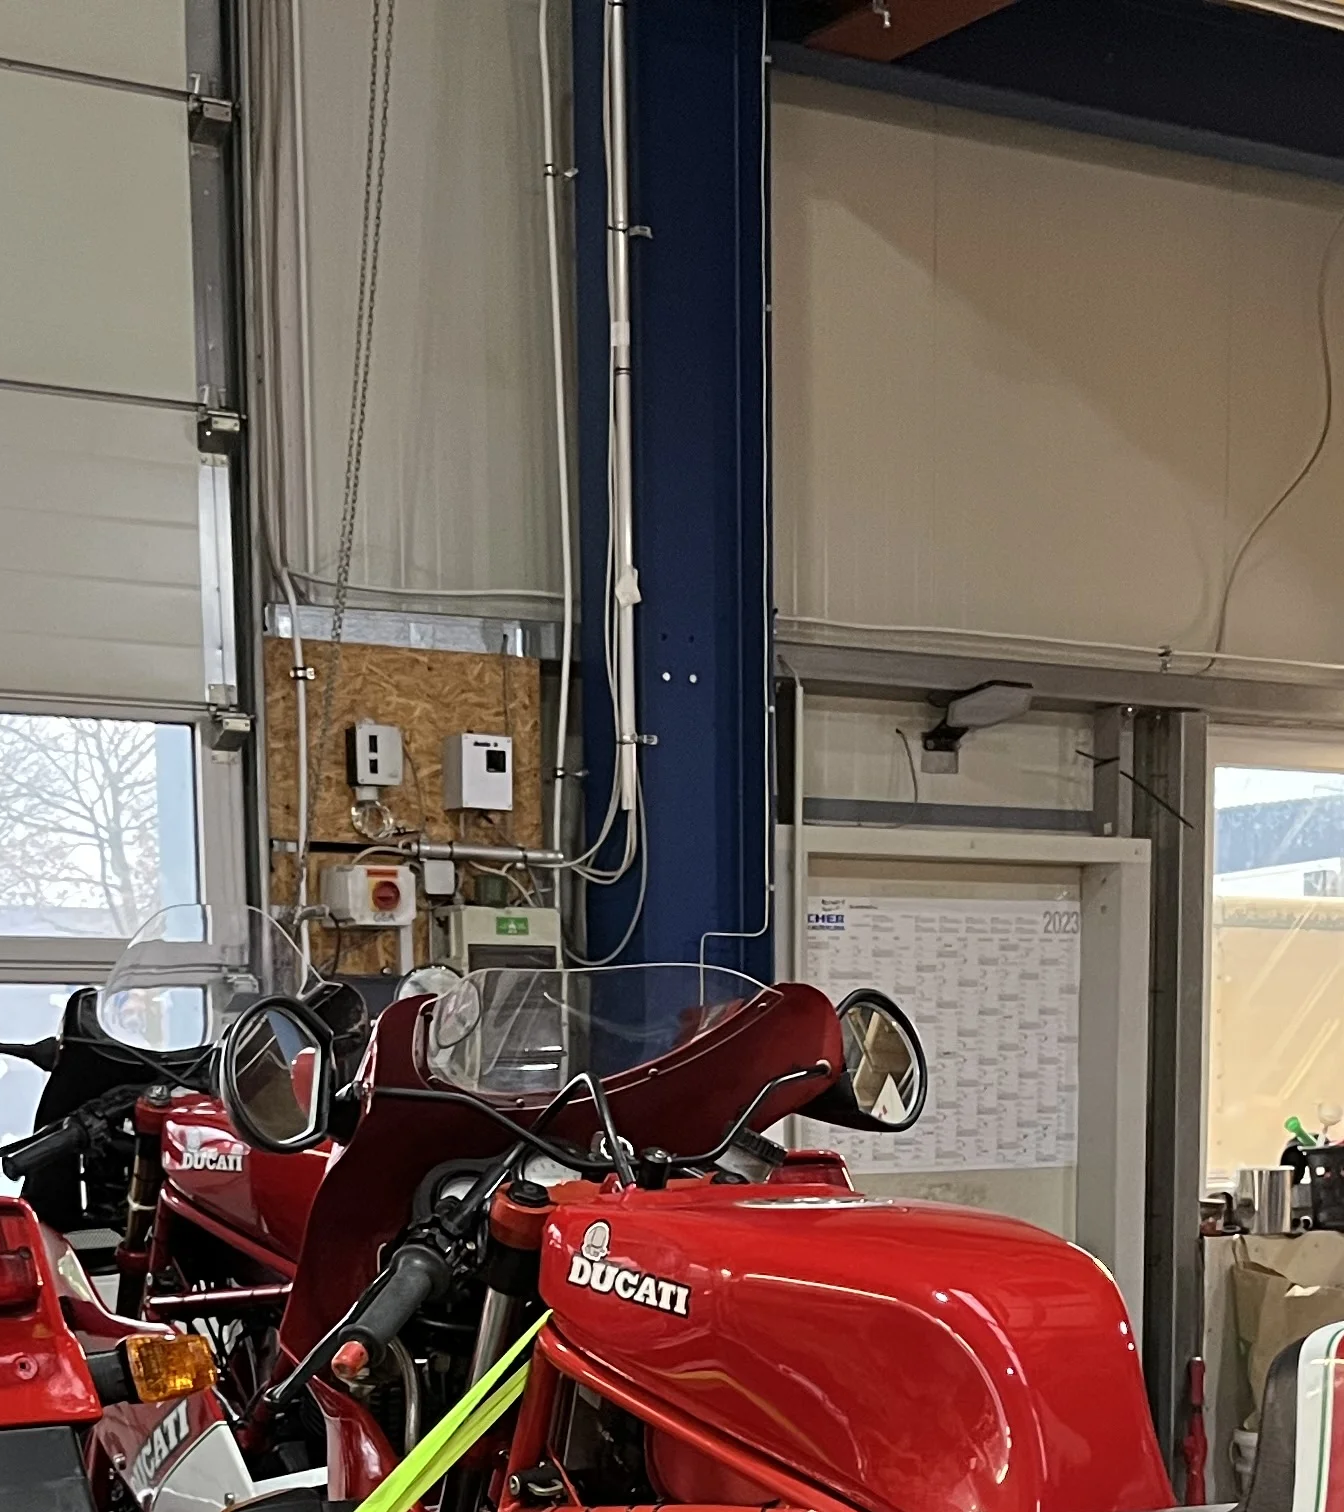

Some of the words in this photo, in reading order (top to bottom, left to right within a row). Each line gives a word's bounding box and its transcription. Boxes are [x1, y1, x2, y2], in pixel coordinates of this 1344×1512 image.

[1042, 911, 1078, 934] 2023
[180, 1151, 243, 1172] DUCATI
[567, 1254, 690, 1316] DUCATI
